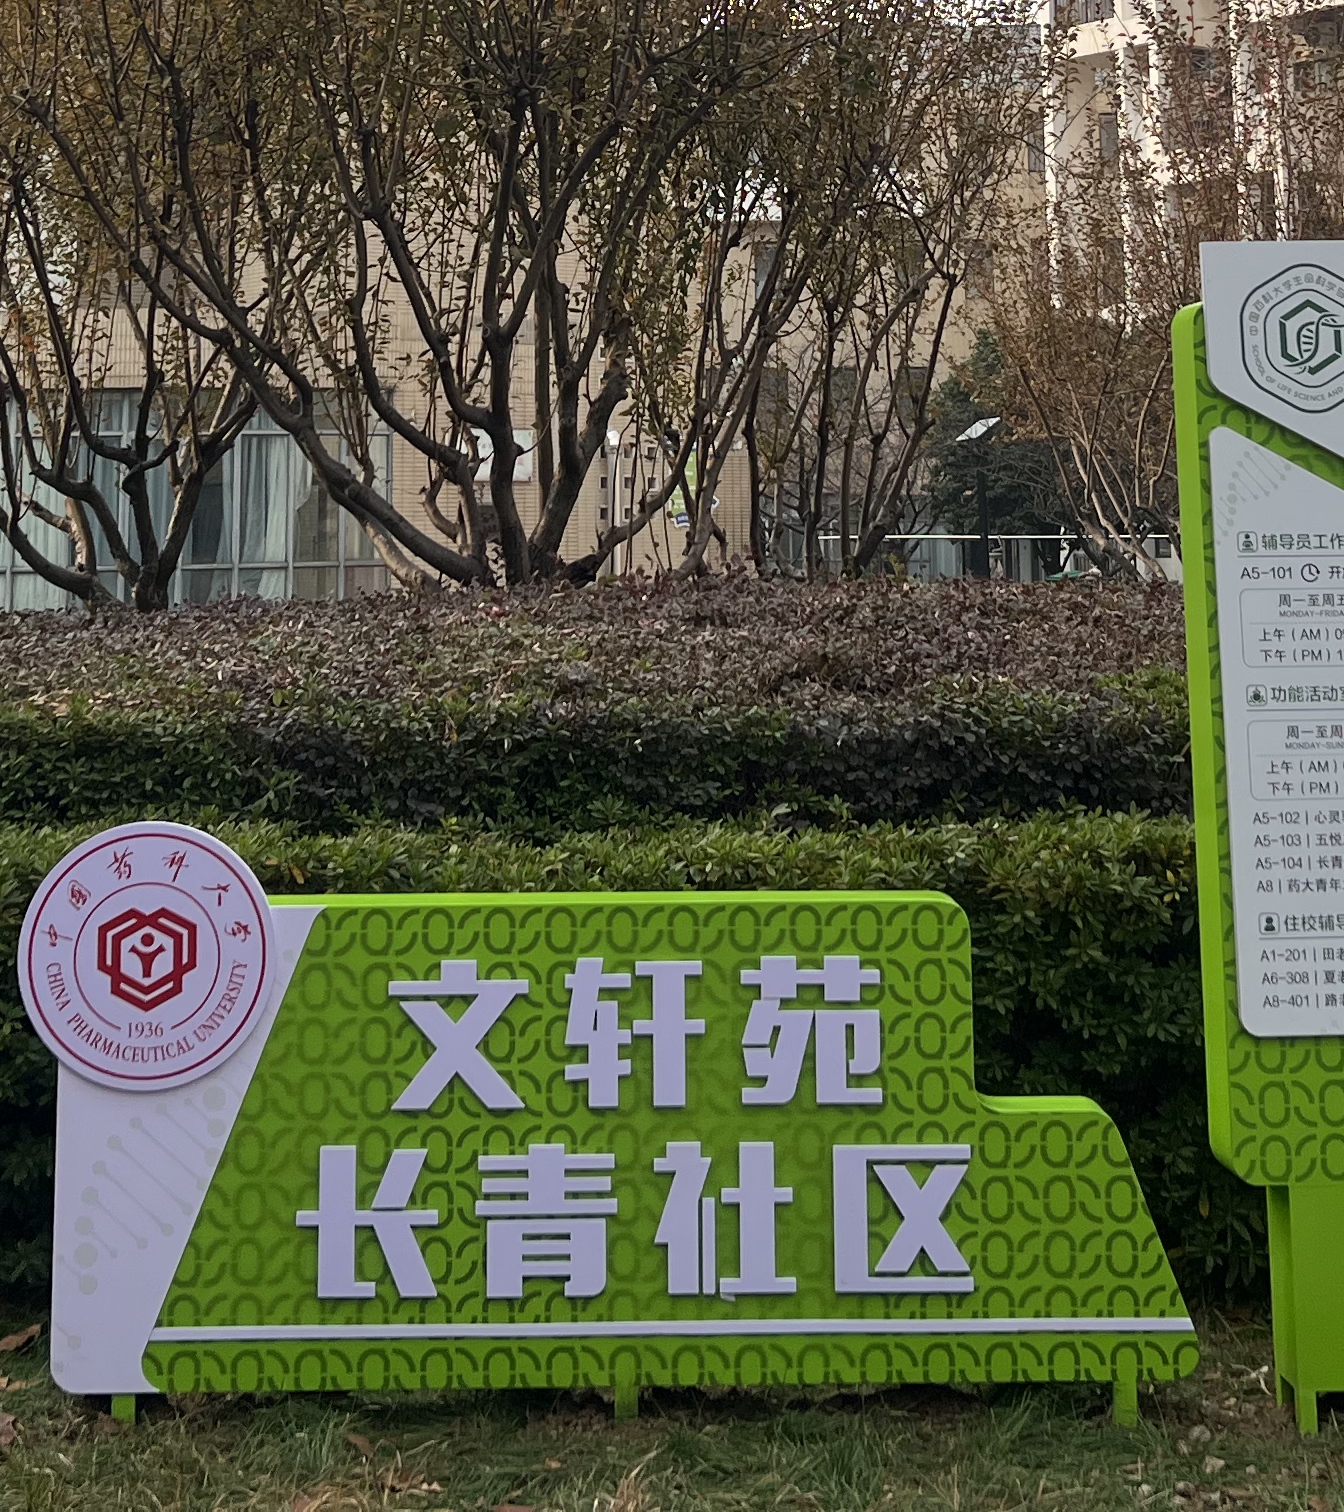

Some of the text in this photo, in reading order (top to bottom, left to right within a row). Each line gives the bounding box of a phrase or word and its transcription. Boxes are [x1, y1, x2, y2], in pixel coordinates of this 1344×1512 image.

[1252, 344, 1266, 377] SCHOOL
[1265, 375, 1276, 385] OF
[1276, 382, 1292, 395] LIFE
[1293, 391, 1326, 402] SCIENCE
[1327, 386, 1344, 398] AND
[1240, 566, 1293, 581] A5-101
[46, 959, 248, 1064] CHINA PHARMACEUTICAL UNIVERSITY
[127, 1021, 164, 1039] 1936
[387, 955, 882, 1111] 文轩苑
[296, 1140, 975, 1301] 长青社区
